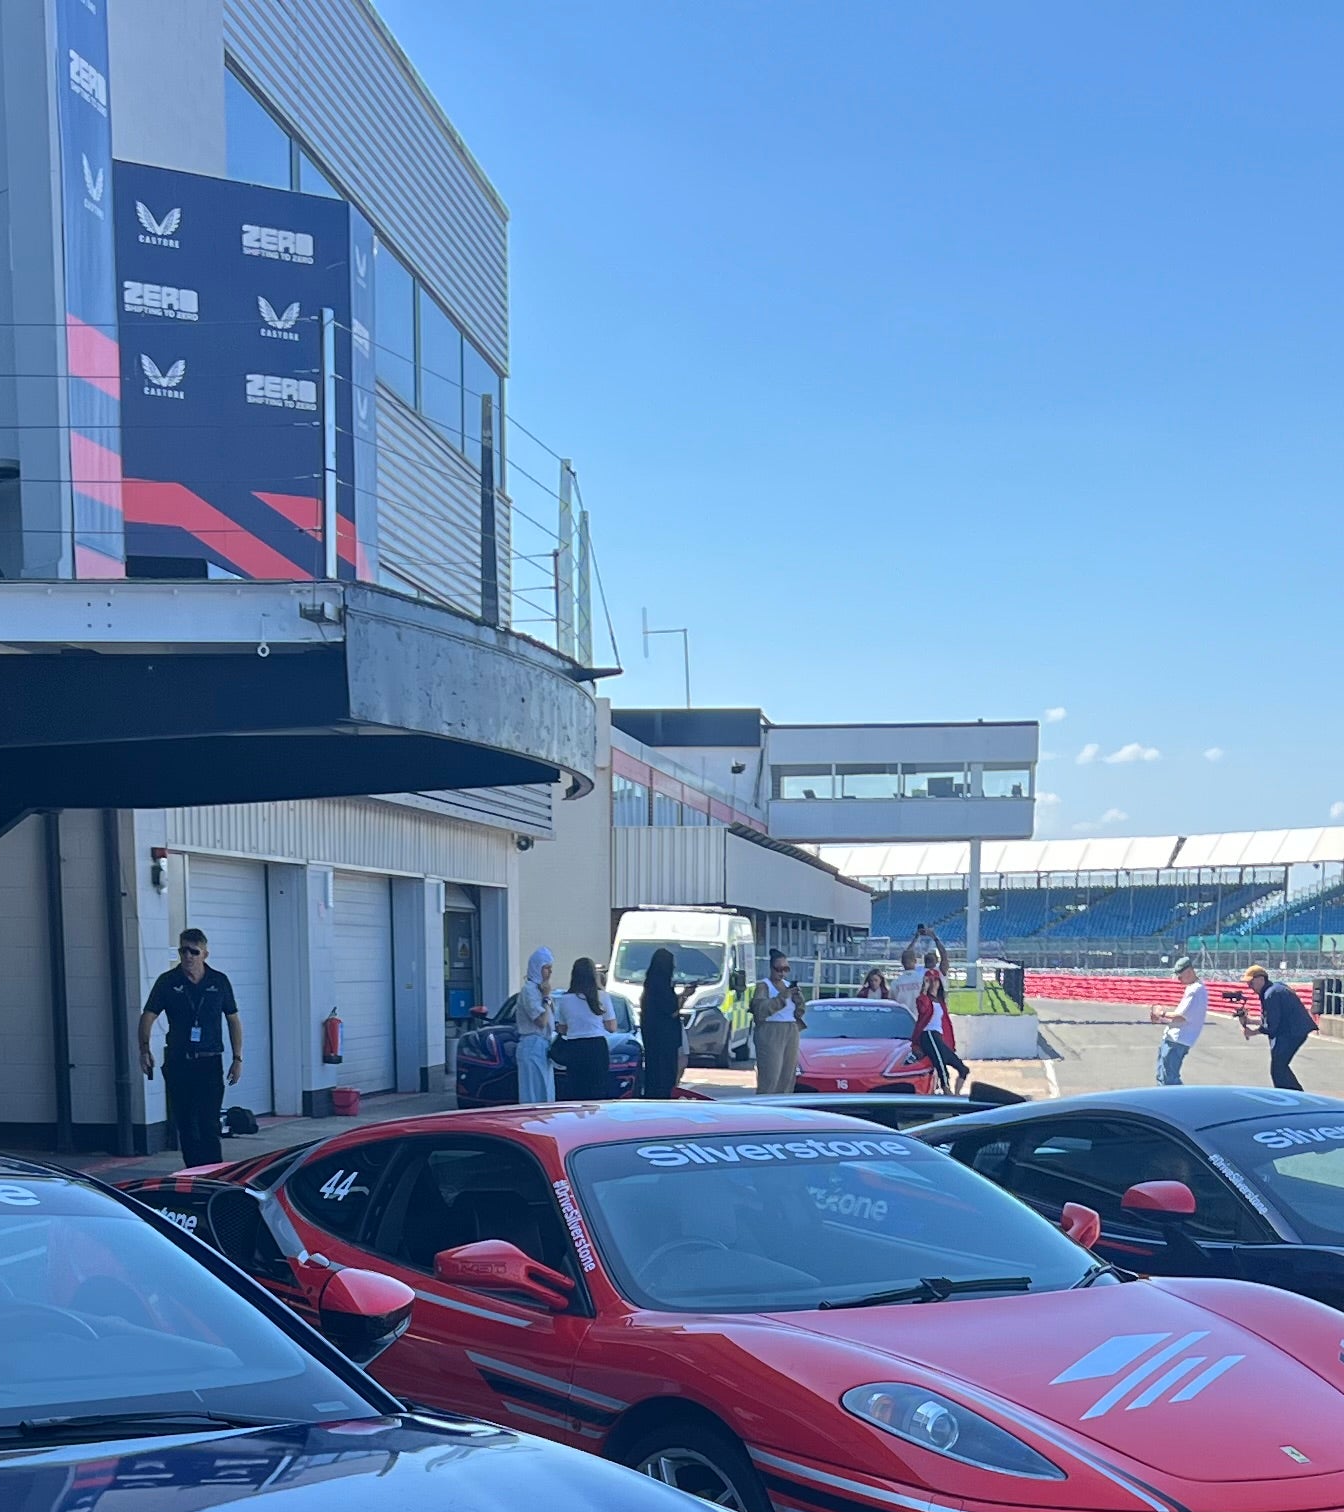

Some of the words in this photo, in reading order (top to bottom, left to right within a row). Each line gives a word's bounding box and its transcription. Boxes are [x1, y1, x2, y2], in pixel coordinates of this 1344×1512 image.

[138, 234, 180, 249] CASTORE
[241, 224, 314, 257] ZERO
[280, 253, 291, 262] TO
[123, 280, 199, 314] ZERO
[163, 309, 176, 319] TO
[260, 328, 300, 341] CASTORE
[143, 386, 185, 400] CASTORE
[245, 373, 317, 403] ZERO
[283, 399, 295, 409] TO
[835, 1079, 849, 1090] 16
[636, 1137, 911, 1168] Silverstone
[319, 1169, 359, 1201] 44
[552, 1179, 596, 1273] #DriveSilverstone
